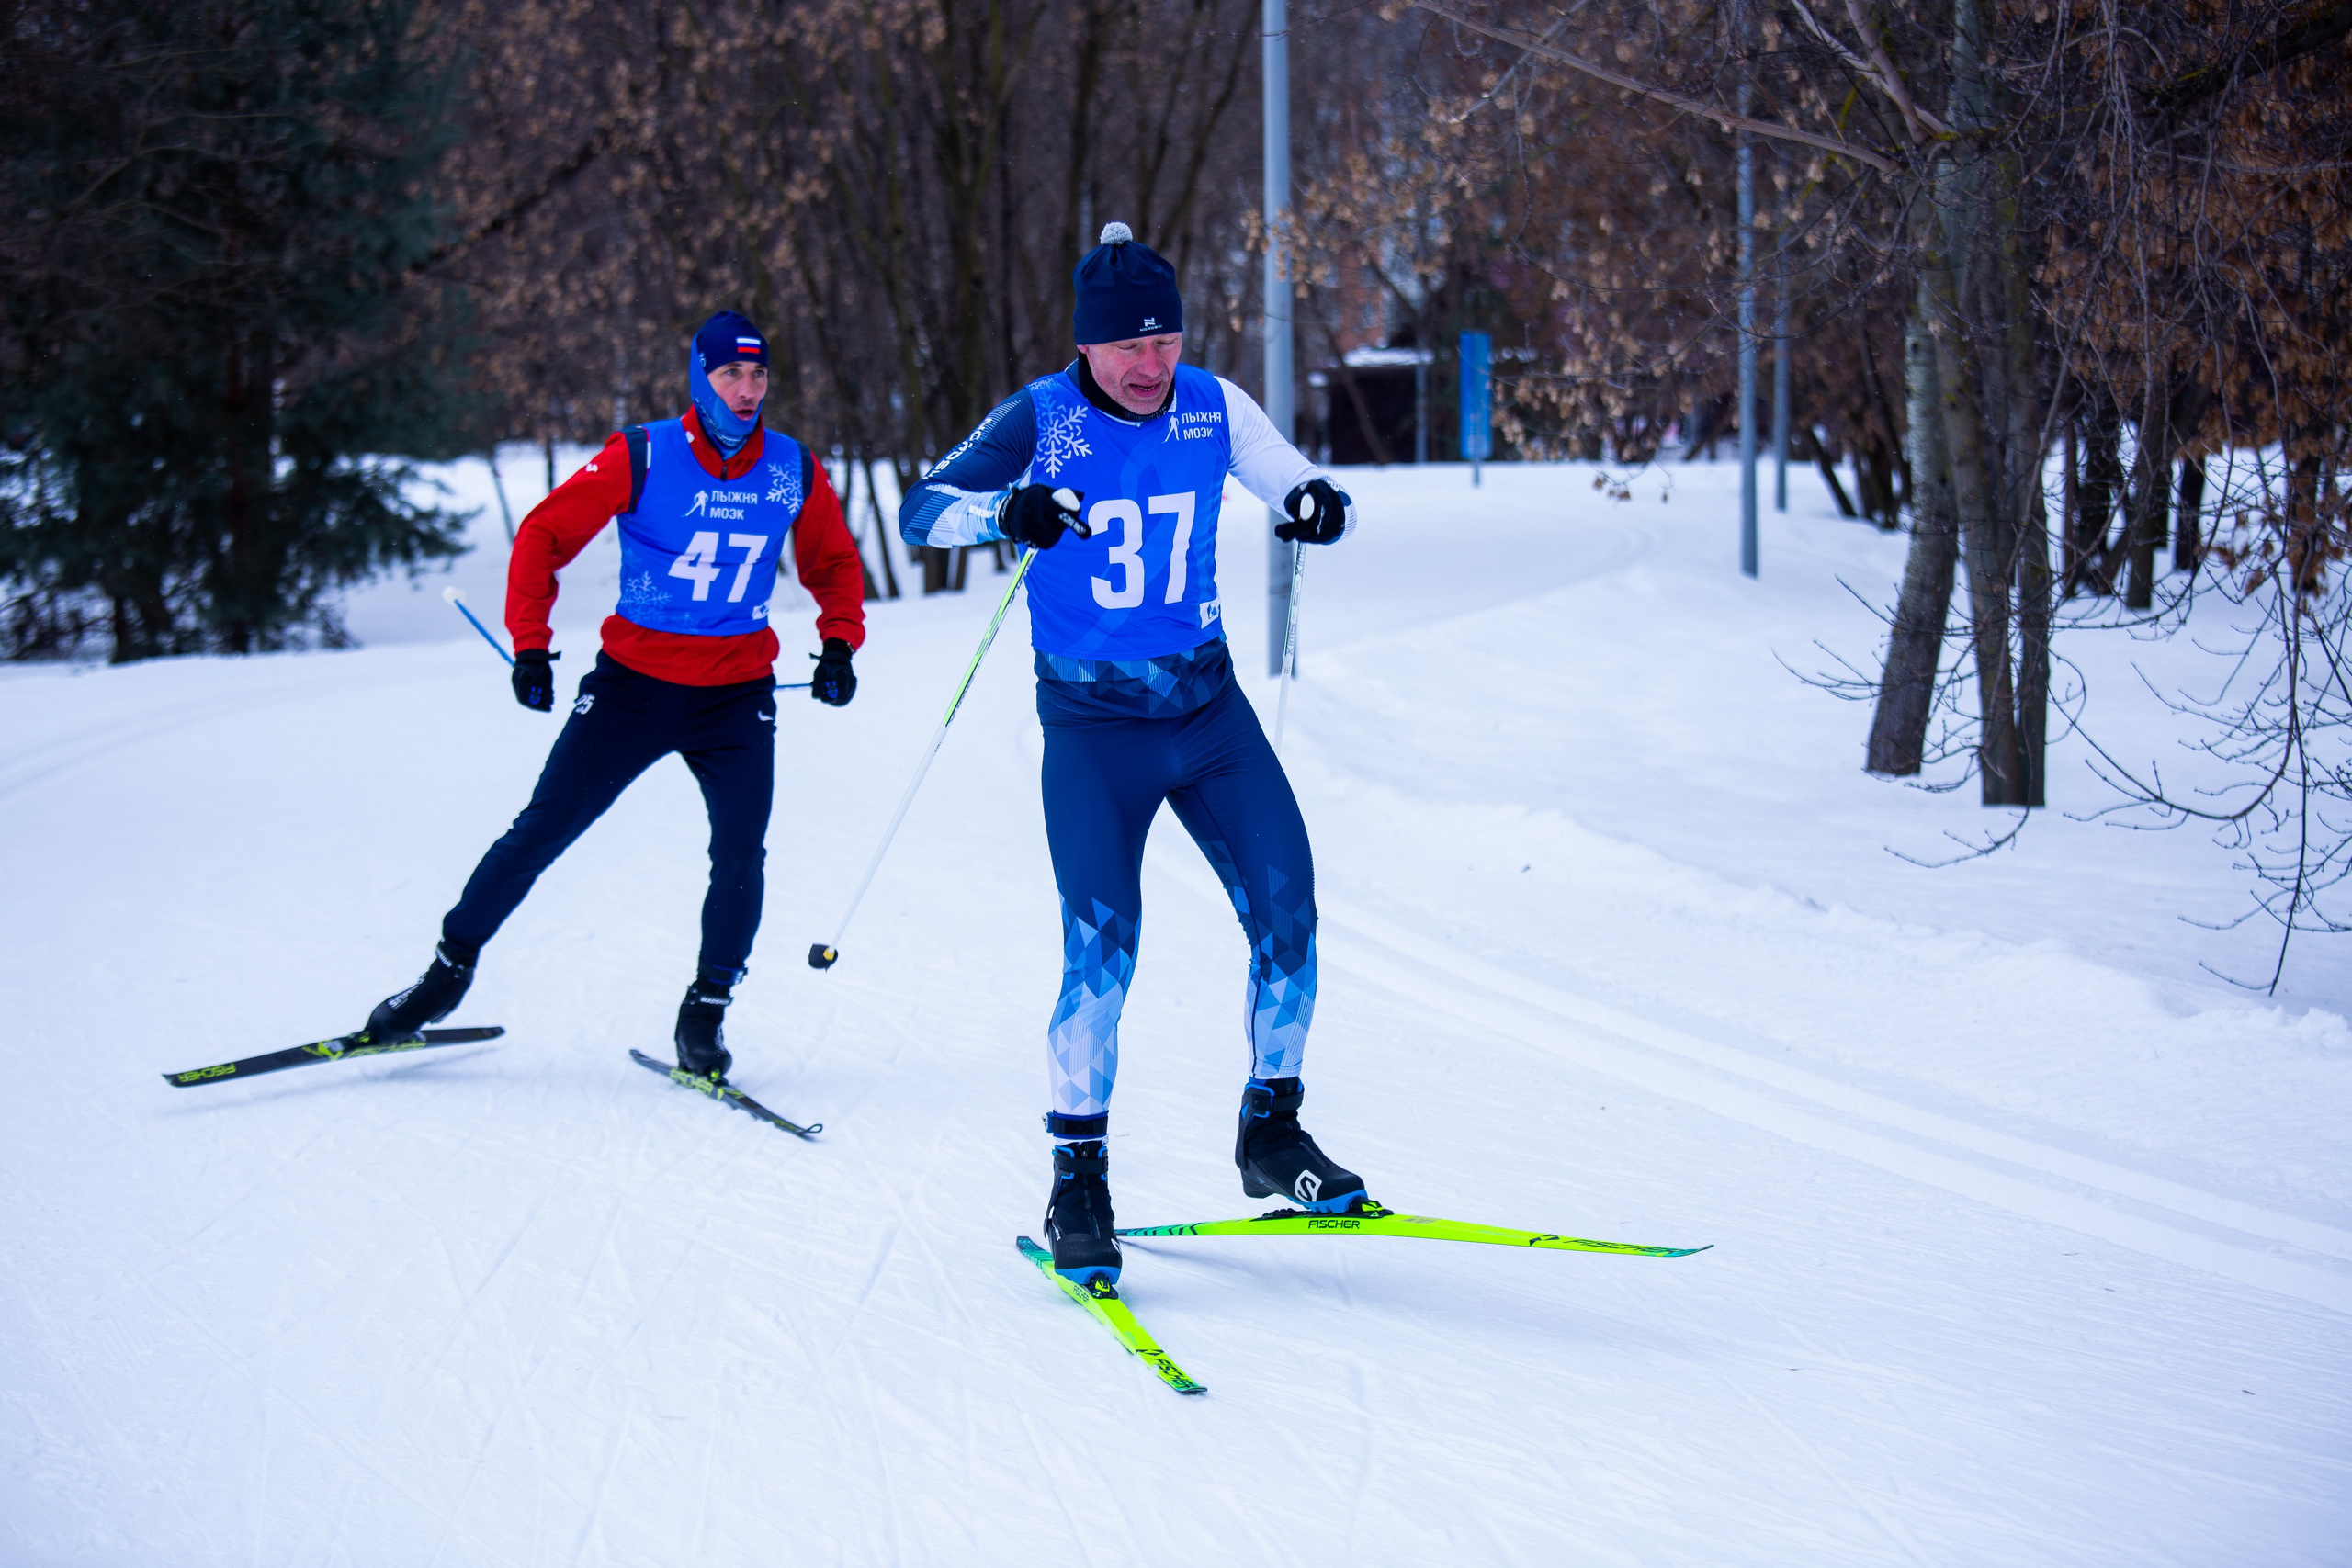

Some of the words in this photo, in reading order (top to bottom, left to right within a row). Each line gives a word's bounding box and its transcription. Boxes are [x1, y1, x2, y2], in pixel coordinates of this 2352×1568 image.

[1181, 412, 1222, 424] ЛЫЖНЯ
[1183, 427, 1214, 441] МОЭК
[711, 490, 758, 505] ЛЫЖНЯ
[709, 507, 744, 521] МОЭК
[1087, 491, 1196, 609] 37
[668, 531, 769, 603] 47
[177, 1063, 236, 1083] FISCHER
[1307, 1219, 1361, 1230] FISCHER
[1073, 1285, 1090, 1304] FISCHER
[1149, 1359, 1197, 1389] FISCHER
